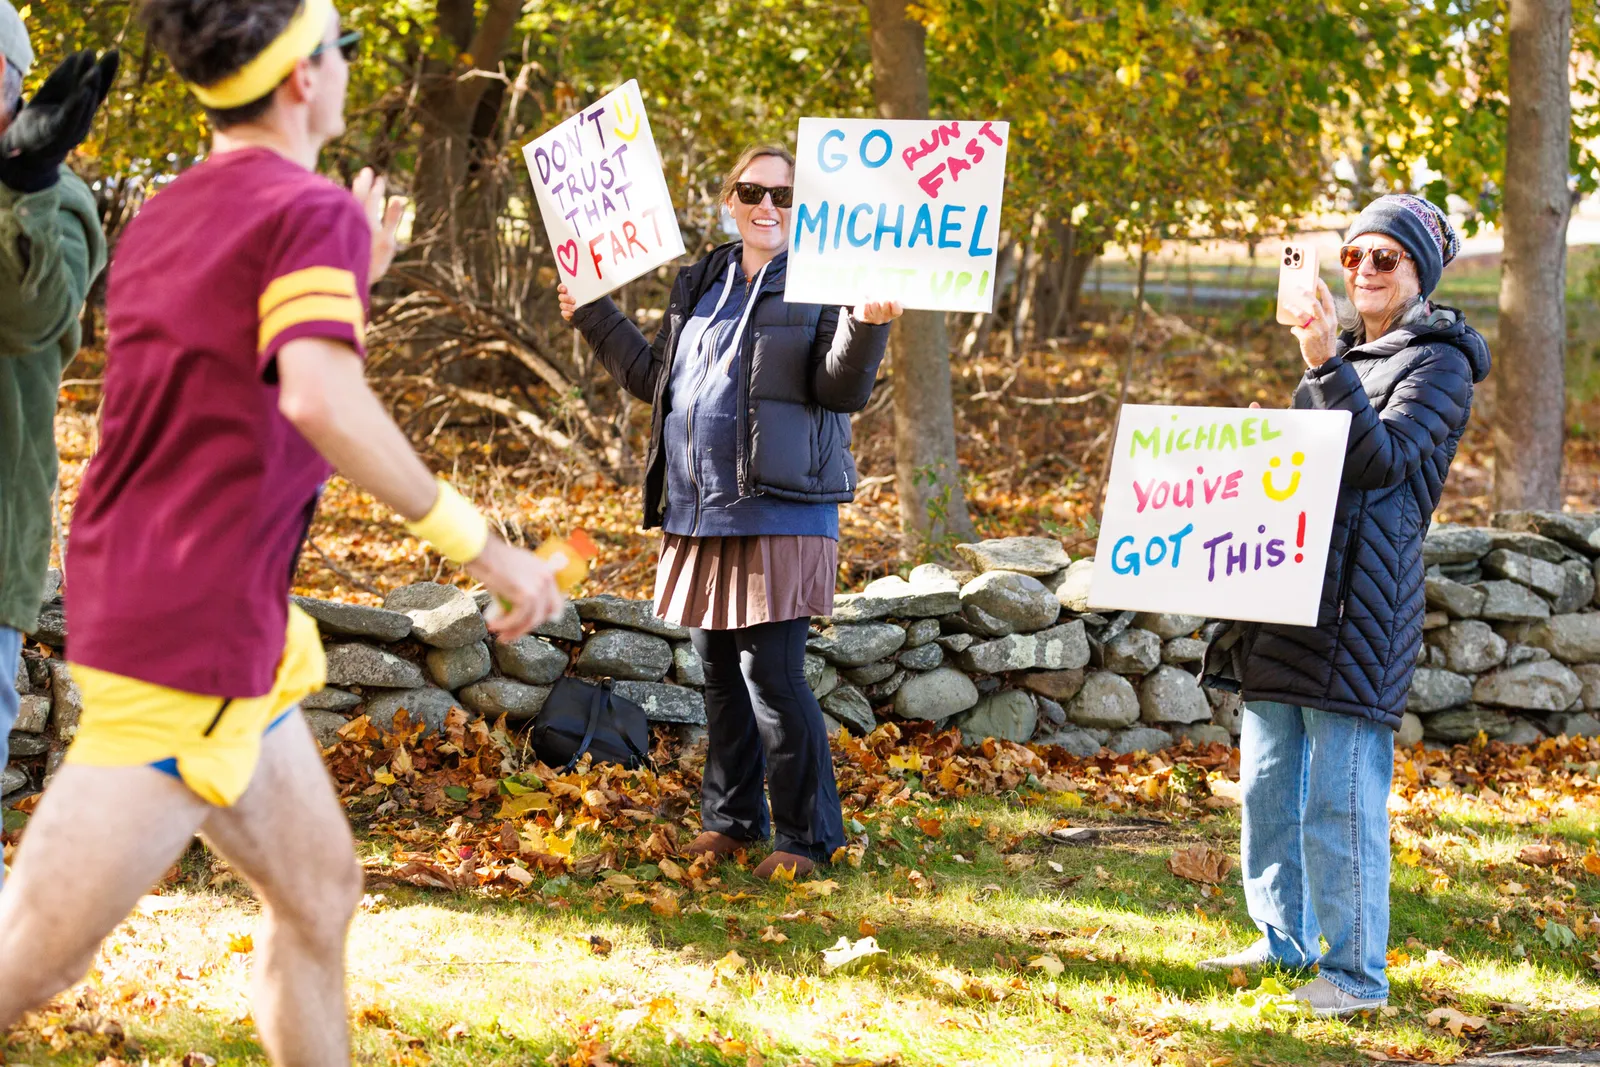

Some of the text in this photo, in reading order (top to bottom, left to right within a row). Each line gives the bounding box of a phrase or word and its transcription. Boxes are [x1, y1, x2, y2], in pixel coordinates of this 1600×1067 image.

[534, 107, 606, 185] DON'T
[817, 128, 893, 173] GO
[902, 121, 961, 171] RUN
[917, 121, 1003, 199] FAST
[551, 143, 628, 212] TRUST
[565, 181, 633, 238] THAT
[794, 200, 993, 257] MICHAEL
[588, 206, 663, 280] FART
[930, 269, 990, 303] UP!
[1111, 523, 1194, 576] GOT
